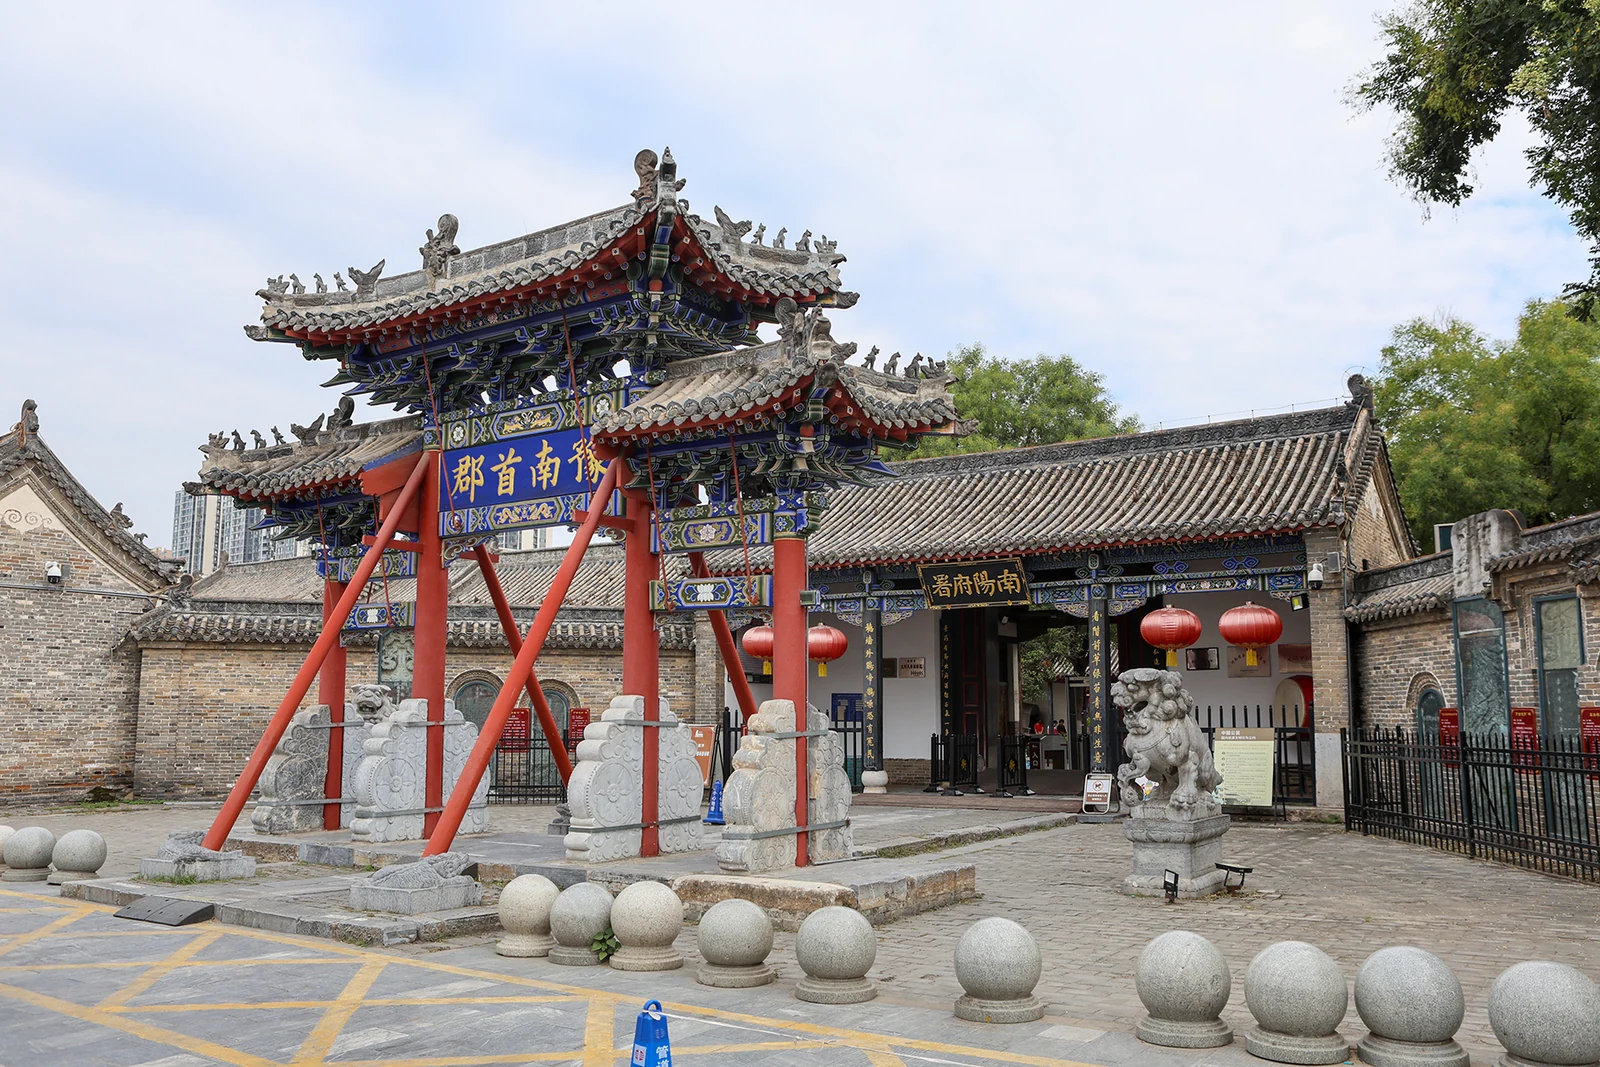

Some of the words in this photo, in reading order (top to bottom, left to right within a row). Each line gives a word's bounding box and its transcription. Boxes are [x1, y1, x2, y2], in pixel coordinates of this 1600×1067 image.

[931, 568, 1021, 598] 南陽府署
[1032, 752, 1039, 767] 入口
